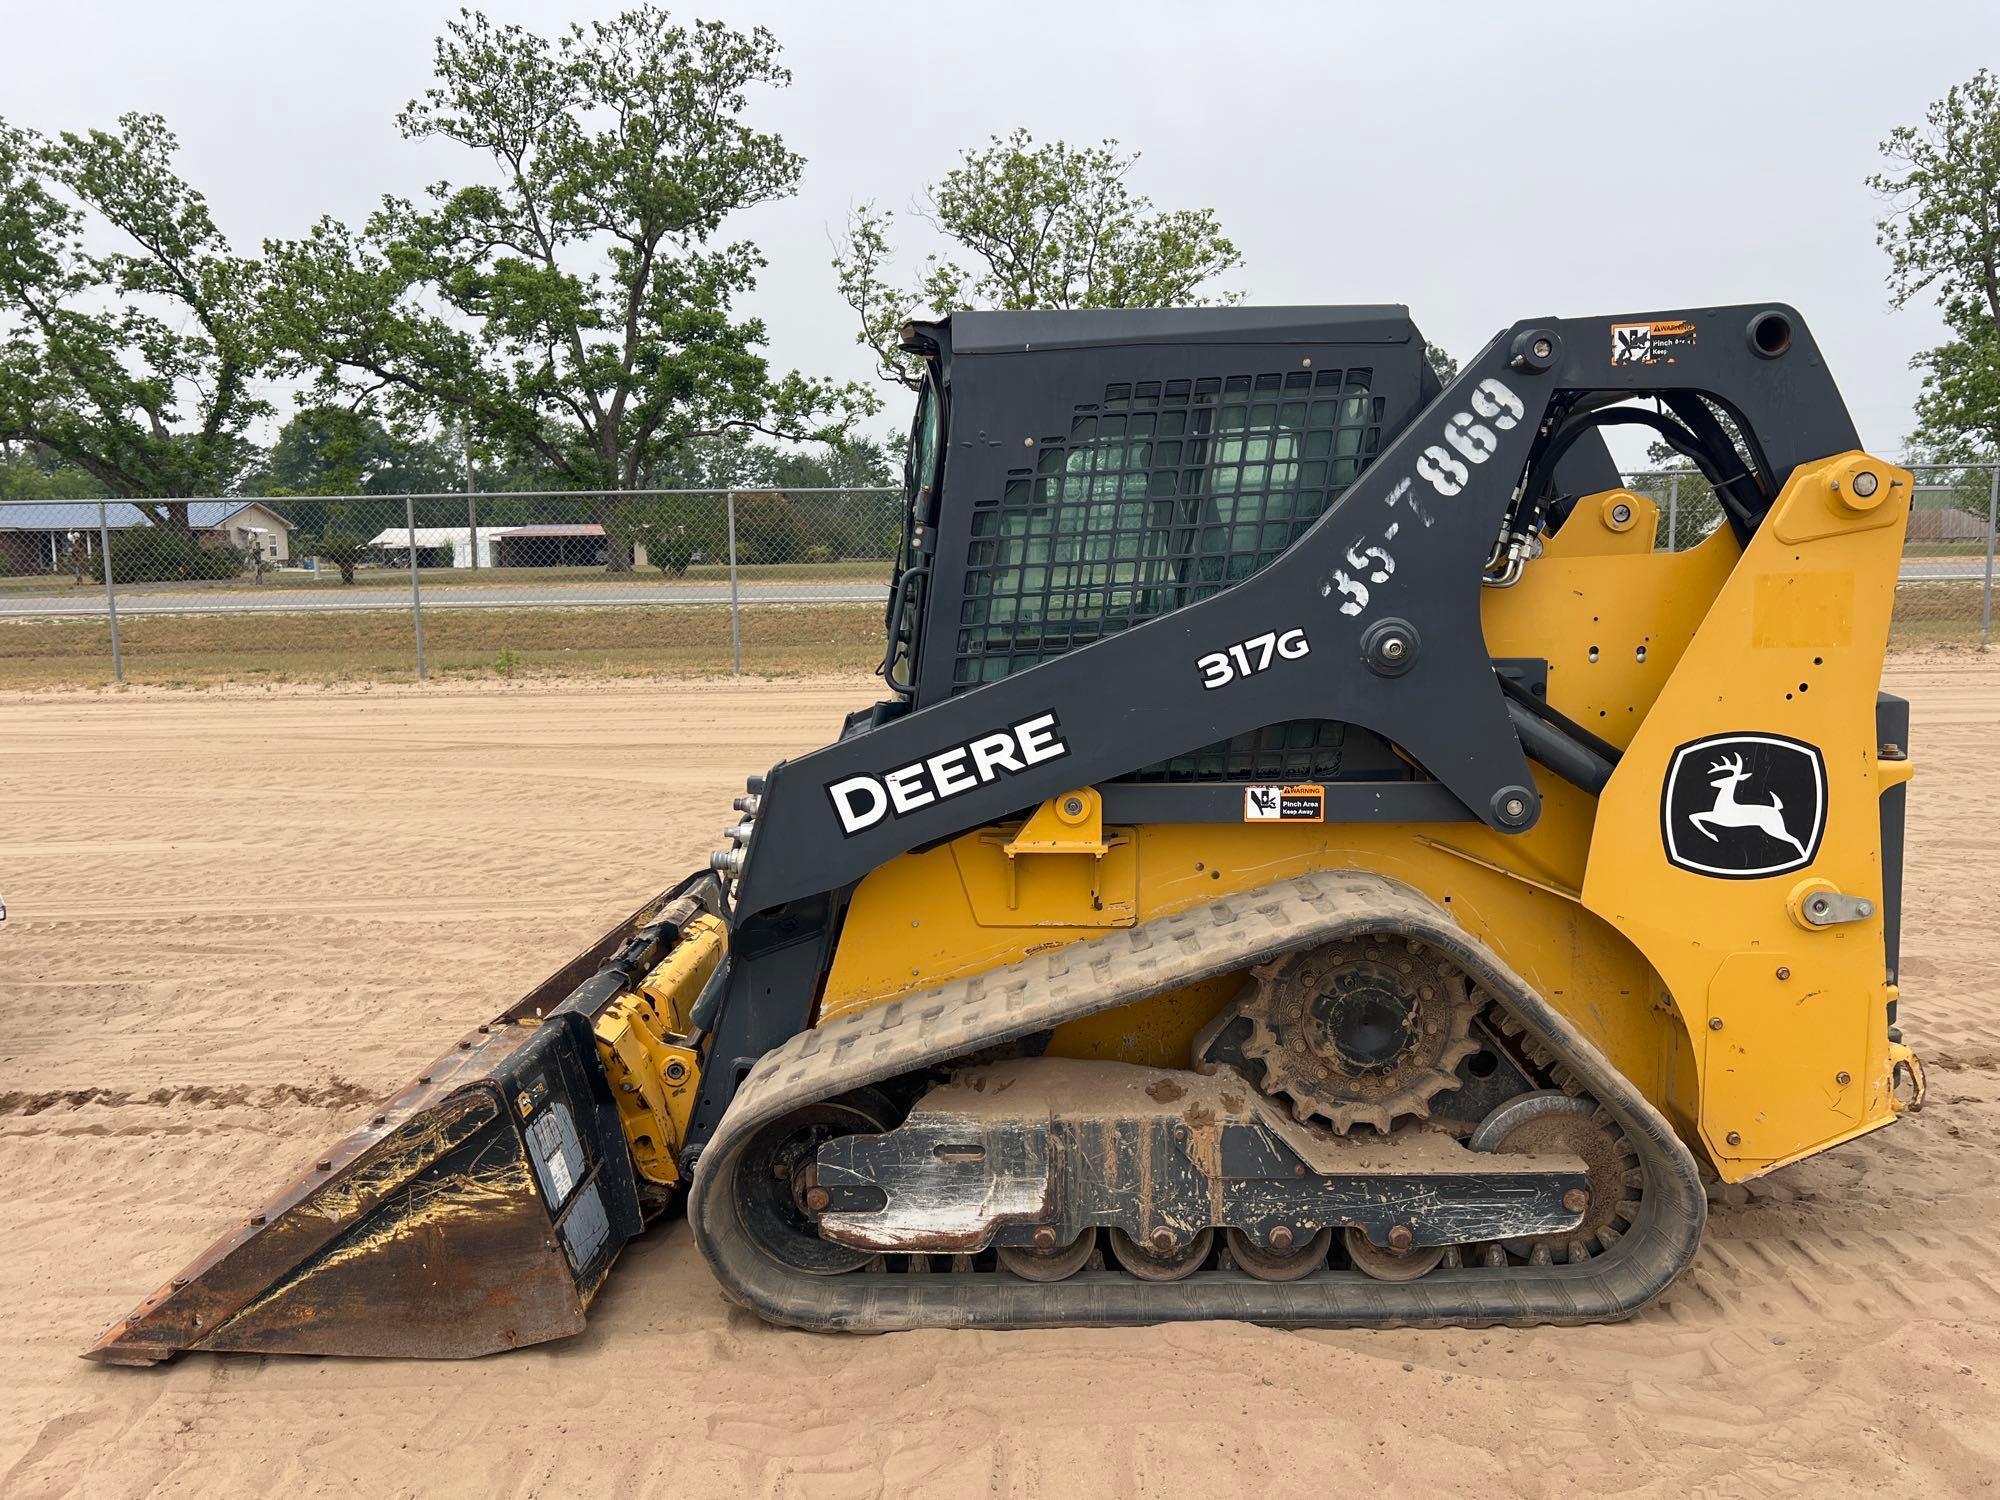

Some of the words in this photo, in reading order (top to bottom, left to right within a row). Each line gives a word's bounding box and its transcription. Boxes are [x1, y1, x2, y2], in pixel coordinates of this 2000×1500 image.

[1652, 339, 1673, 347] Pinch
[1320, 378, 1525, 616] 35-7869
[1197, 628, 1310, 689] 317G
[829, 713, 1066, 834] DEERE
